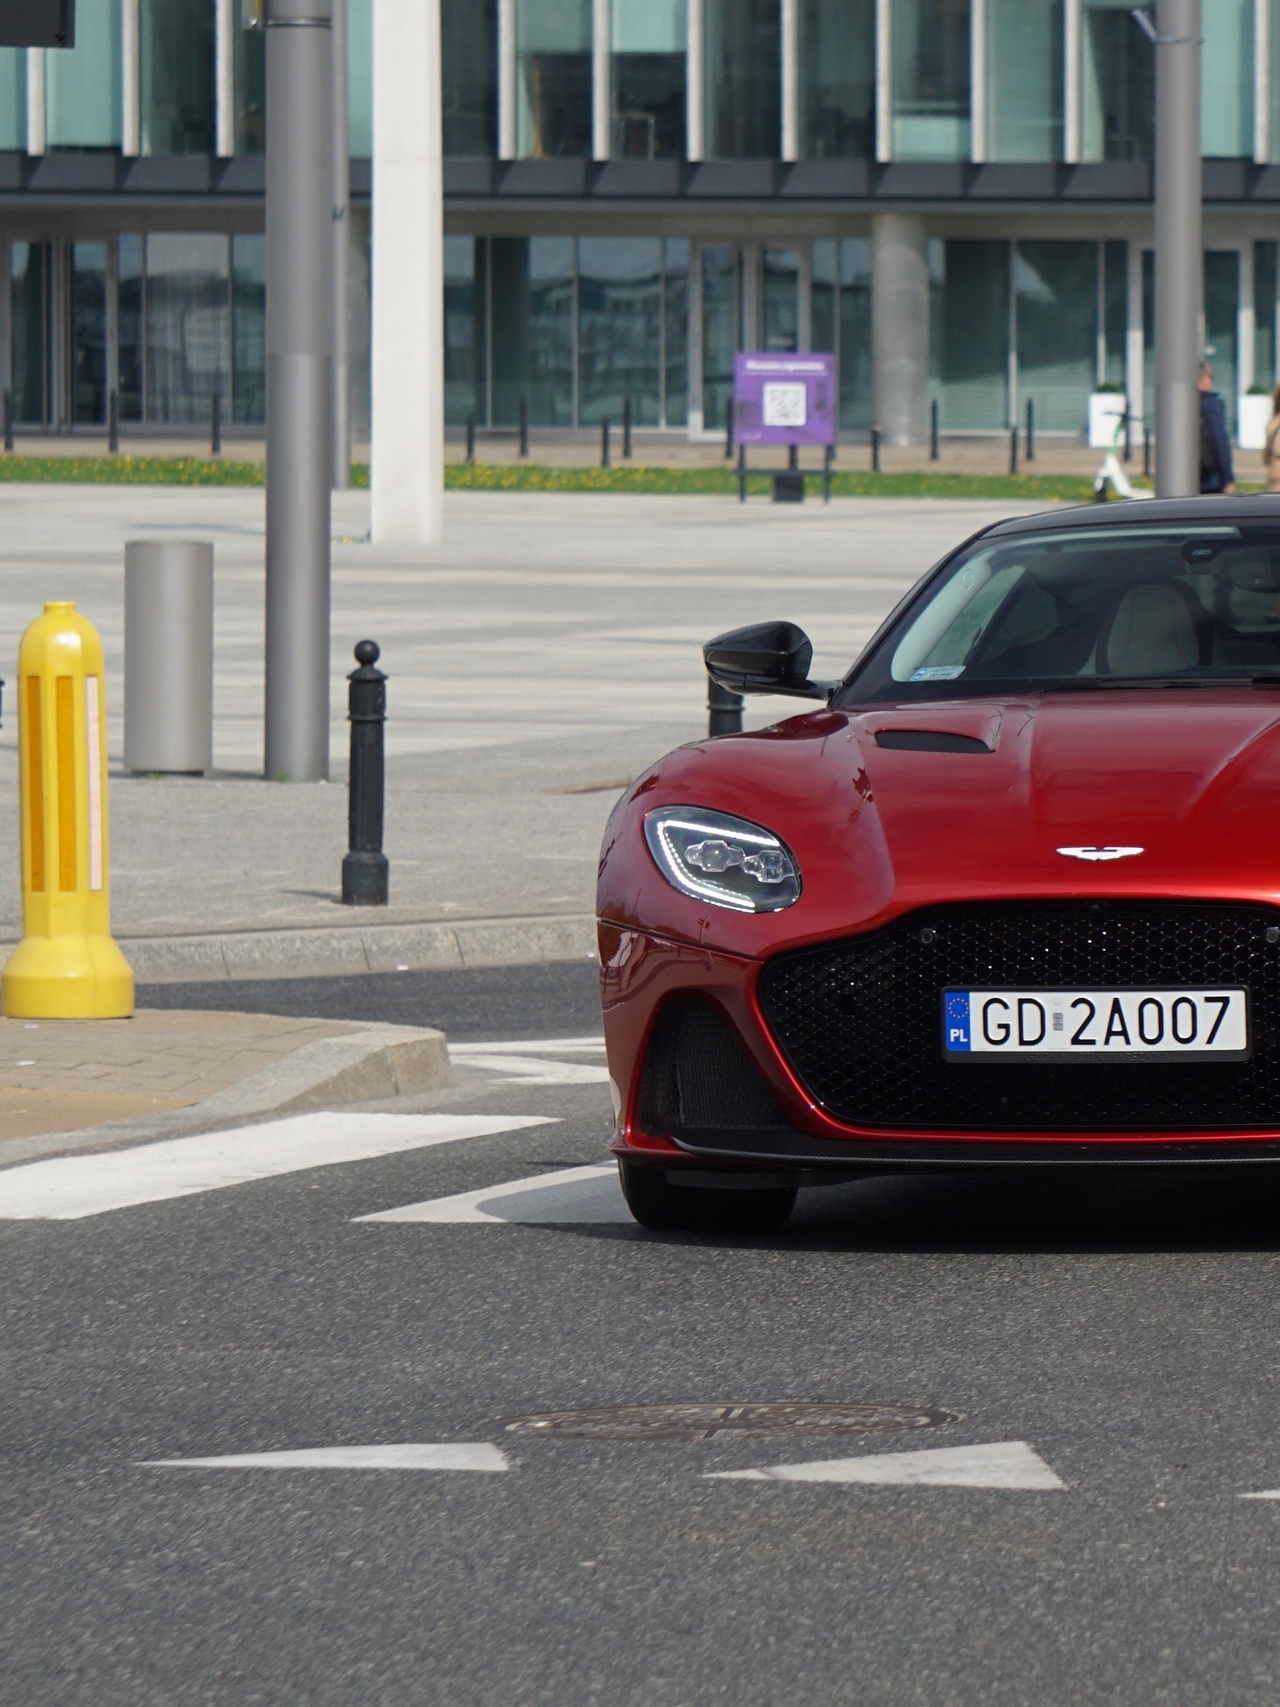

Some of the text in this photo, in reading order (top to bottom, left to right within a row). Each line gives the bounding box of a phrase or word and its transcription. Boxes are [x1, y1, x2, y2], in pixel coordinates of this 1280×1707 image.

[949, 1028, 968, 1043] PL
[982, 996, 1231, 1046] GD 2A007
